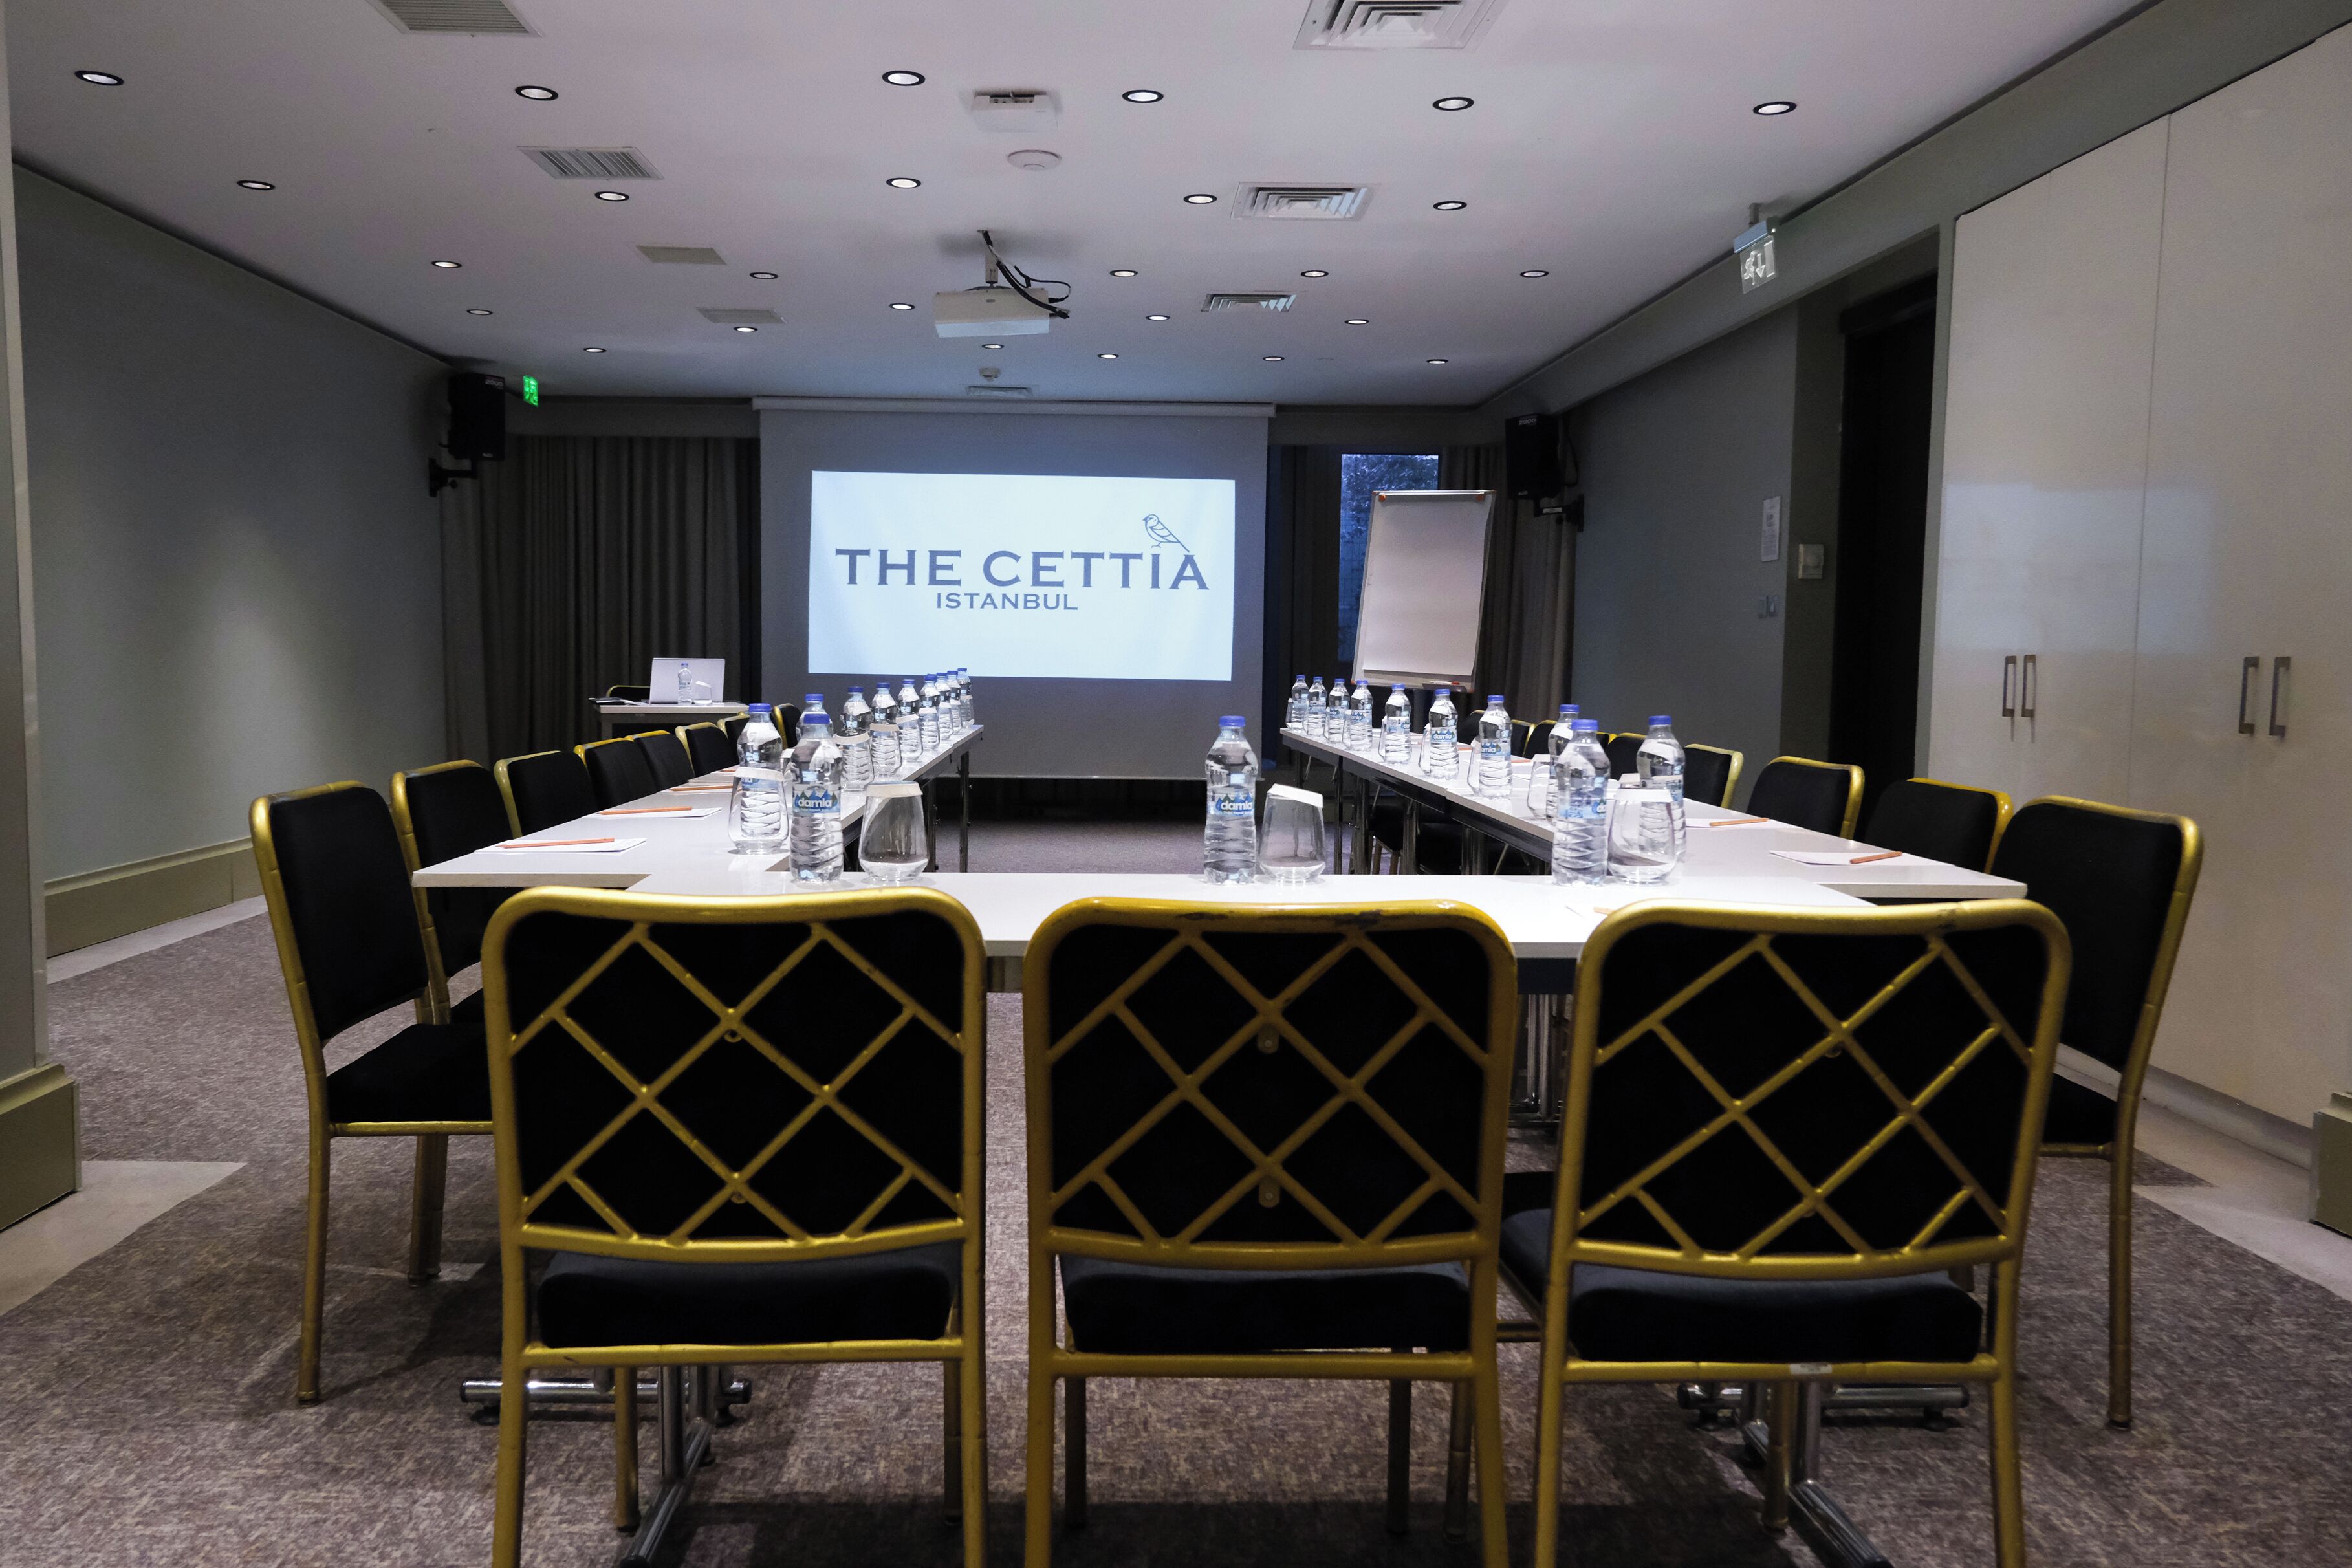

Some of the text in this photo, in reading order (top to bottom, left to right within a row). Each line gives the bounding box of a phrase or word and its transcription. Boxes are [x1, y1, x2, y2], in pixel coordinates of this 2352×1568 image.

[835, 548, 1210, 591] THE CETTIA
[935, 593, 1079, 611] ISTANBUL
[798, 797, 833, 807] damla
[1220, 800, 1253, 810] damla
